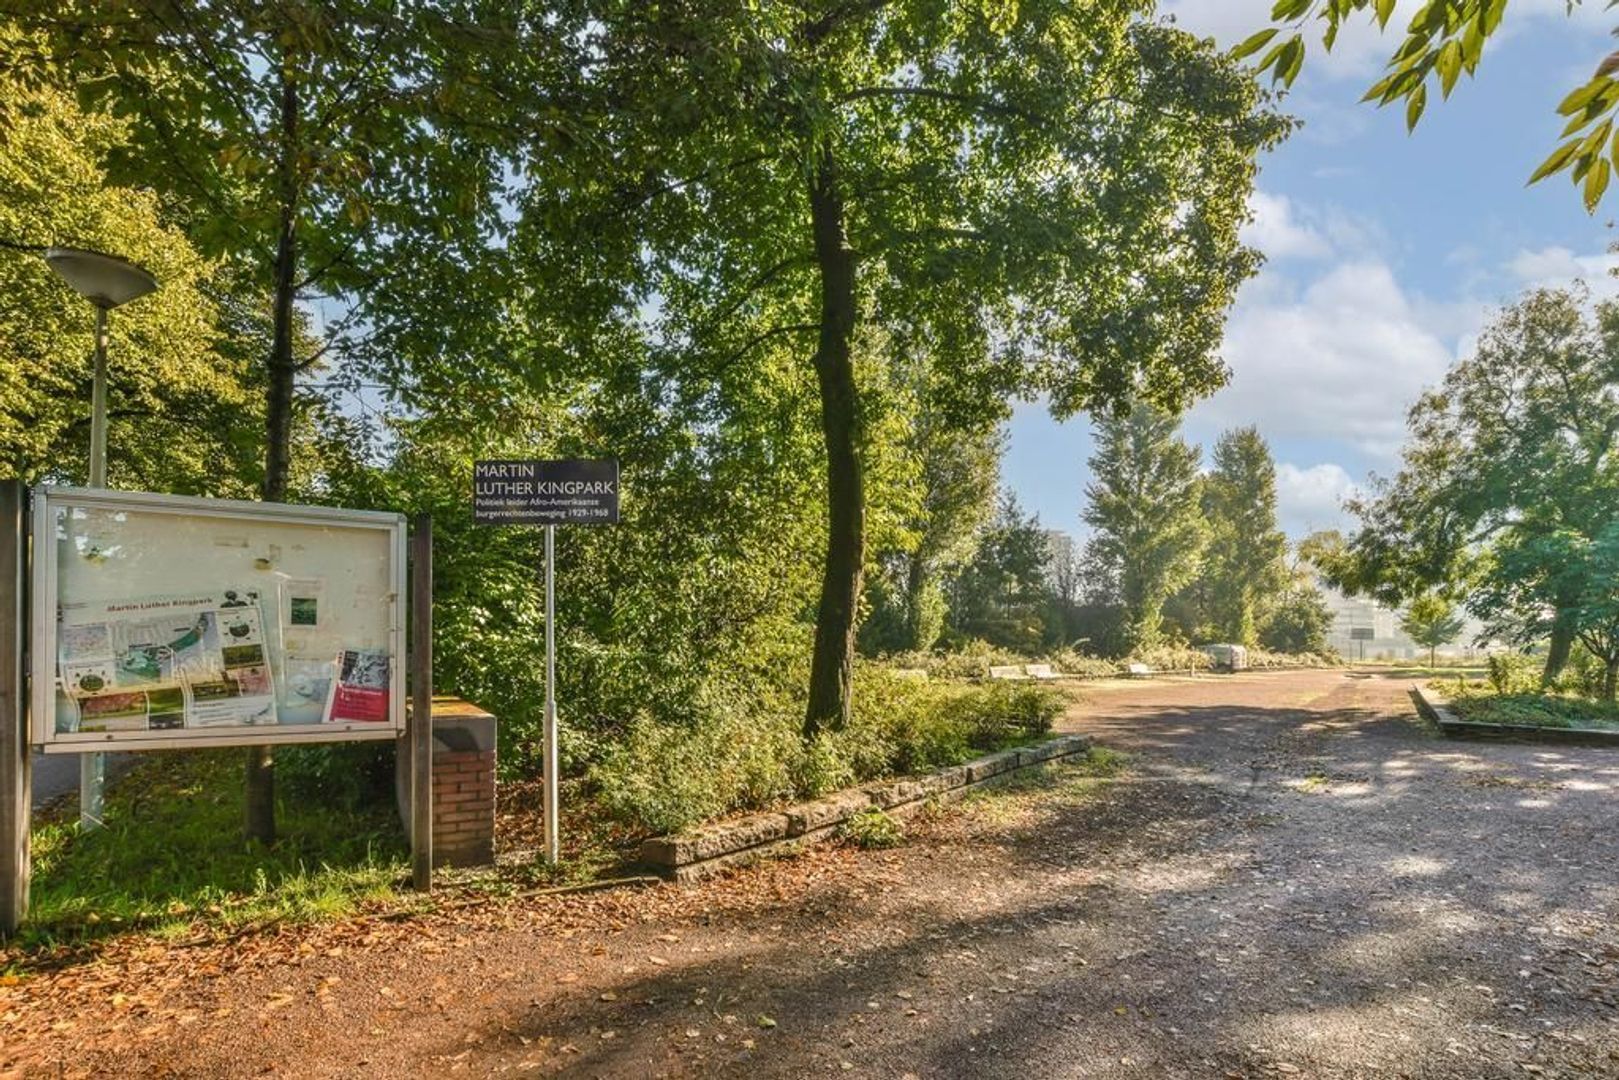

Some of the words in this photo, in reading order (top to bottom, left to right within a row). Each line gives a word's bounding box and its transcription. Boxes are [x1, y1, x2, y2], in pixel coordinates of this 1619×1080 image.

[476, 464, 535, 478] MARTIN
[476, 482, 534, 495] LUTHER
[538, 481, 614, 495] KINGPARK
[476, 498, 504, 506] Politiek
[506, 498, 528, 506] leider
[530, 498, 600, 506] Afro-Amerikaanse
[476, 509, 566, 519] burgerrechtenbeweging
[568, 509, 609, 518] 1929-1968
[107, 602, 139, 612] Martin
[141, 600, 170, 609] Luther
